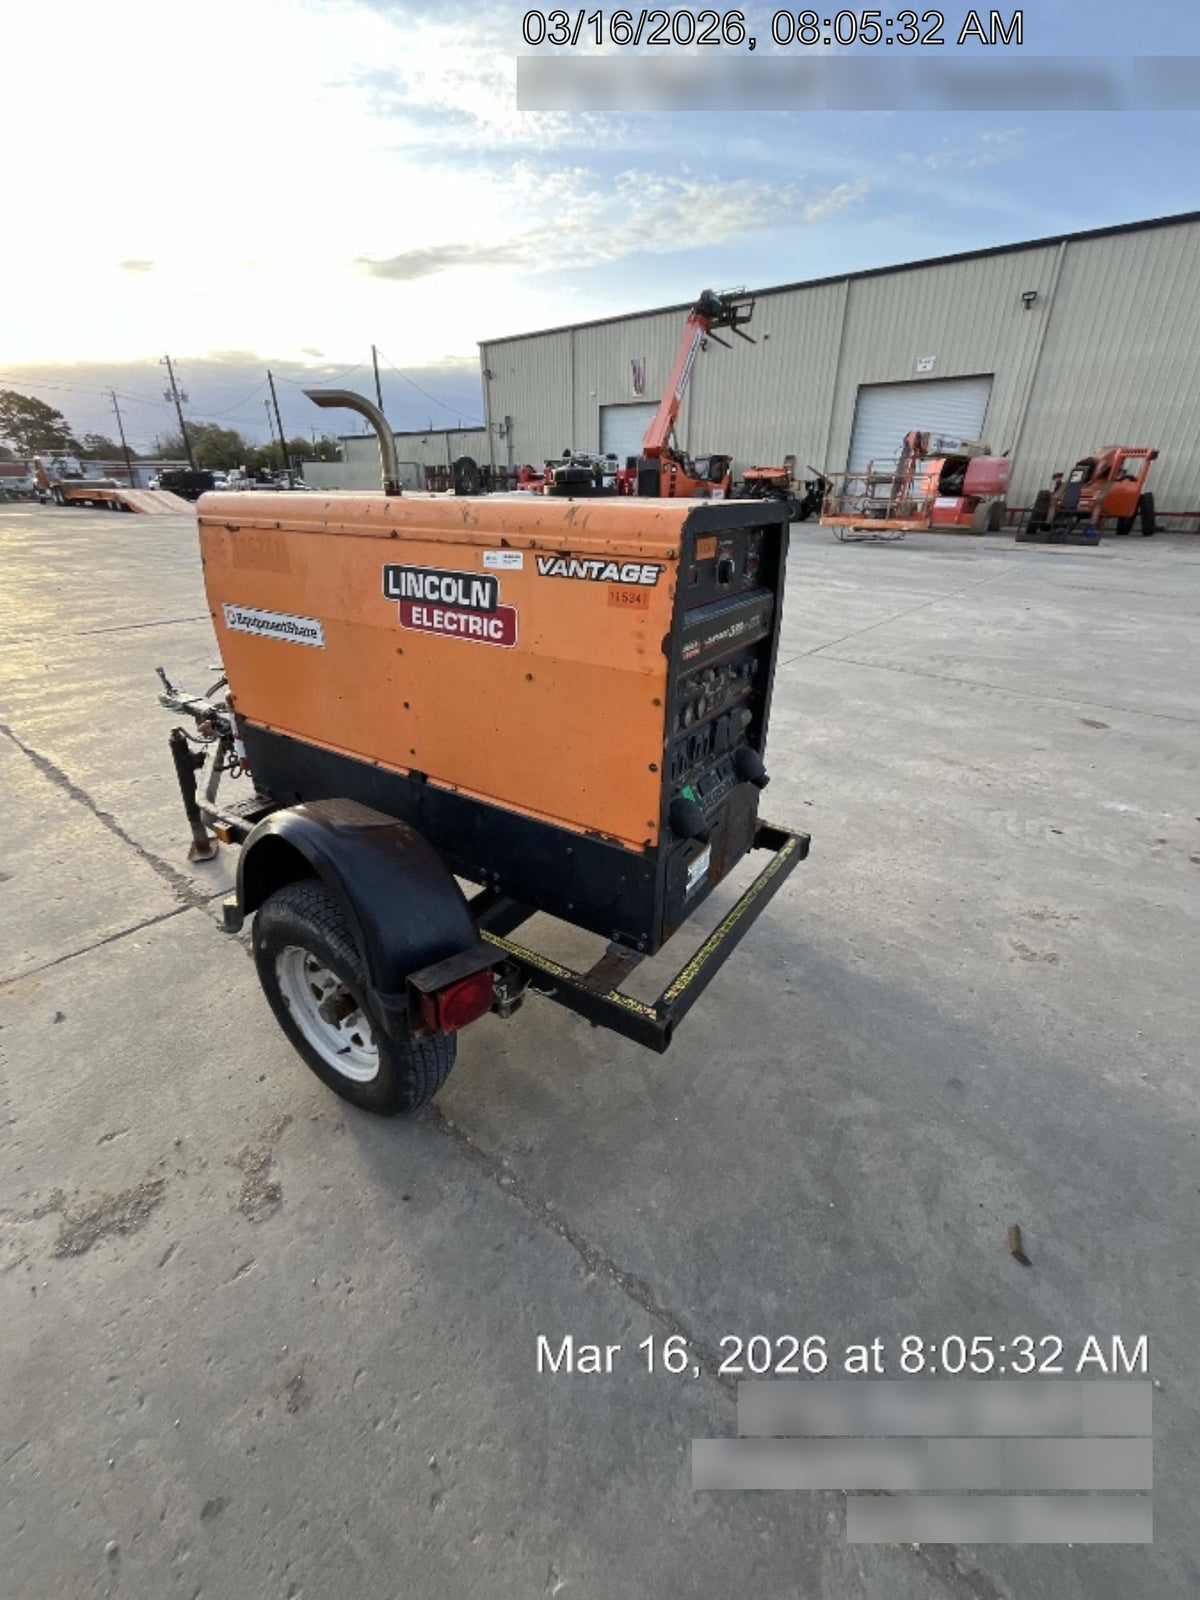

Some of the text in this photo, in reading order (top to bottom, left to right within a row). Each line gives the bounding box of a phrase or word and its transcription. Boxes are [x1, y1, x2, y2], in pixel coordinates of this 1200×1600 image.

[536, 557, 660, 585] VANTAGE
[388, 570, 491, 609] LINCOLN
[411, 605, 504, 639] ELECTRIC
